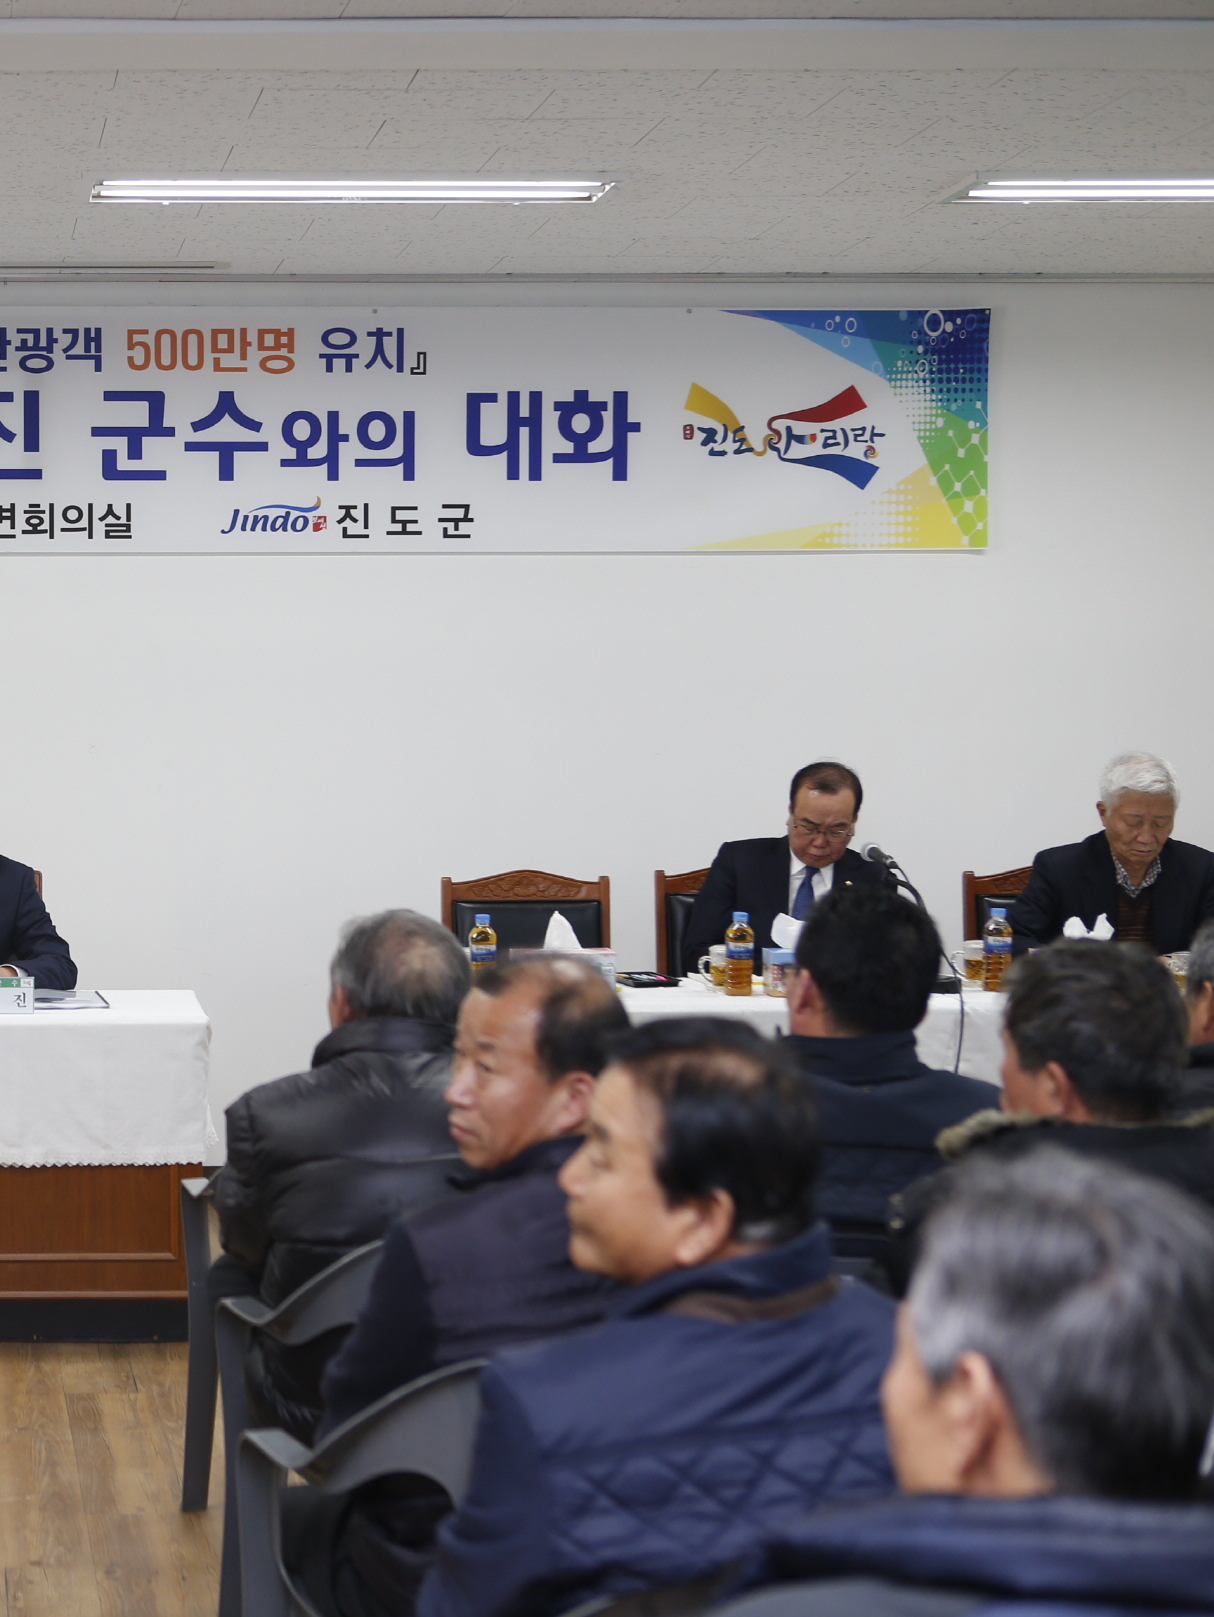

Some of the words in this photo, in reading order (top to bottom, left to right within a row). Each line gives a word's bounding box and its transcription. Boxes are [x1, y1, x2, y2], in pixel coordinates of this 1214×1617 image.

[127, 327, 296, 375] 500만명
[90, 390, 416, 482] 군수와의
[465, 389, 643, 482] 대화
[220, 508, 309, 534] Jindo
